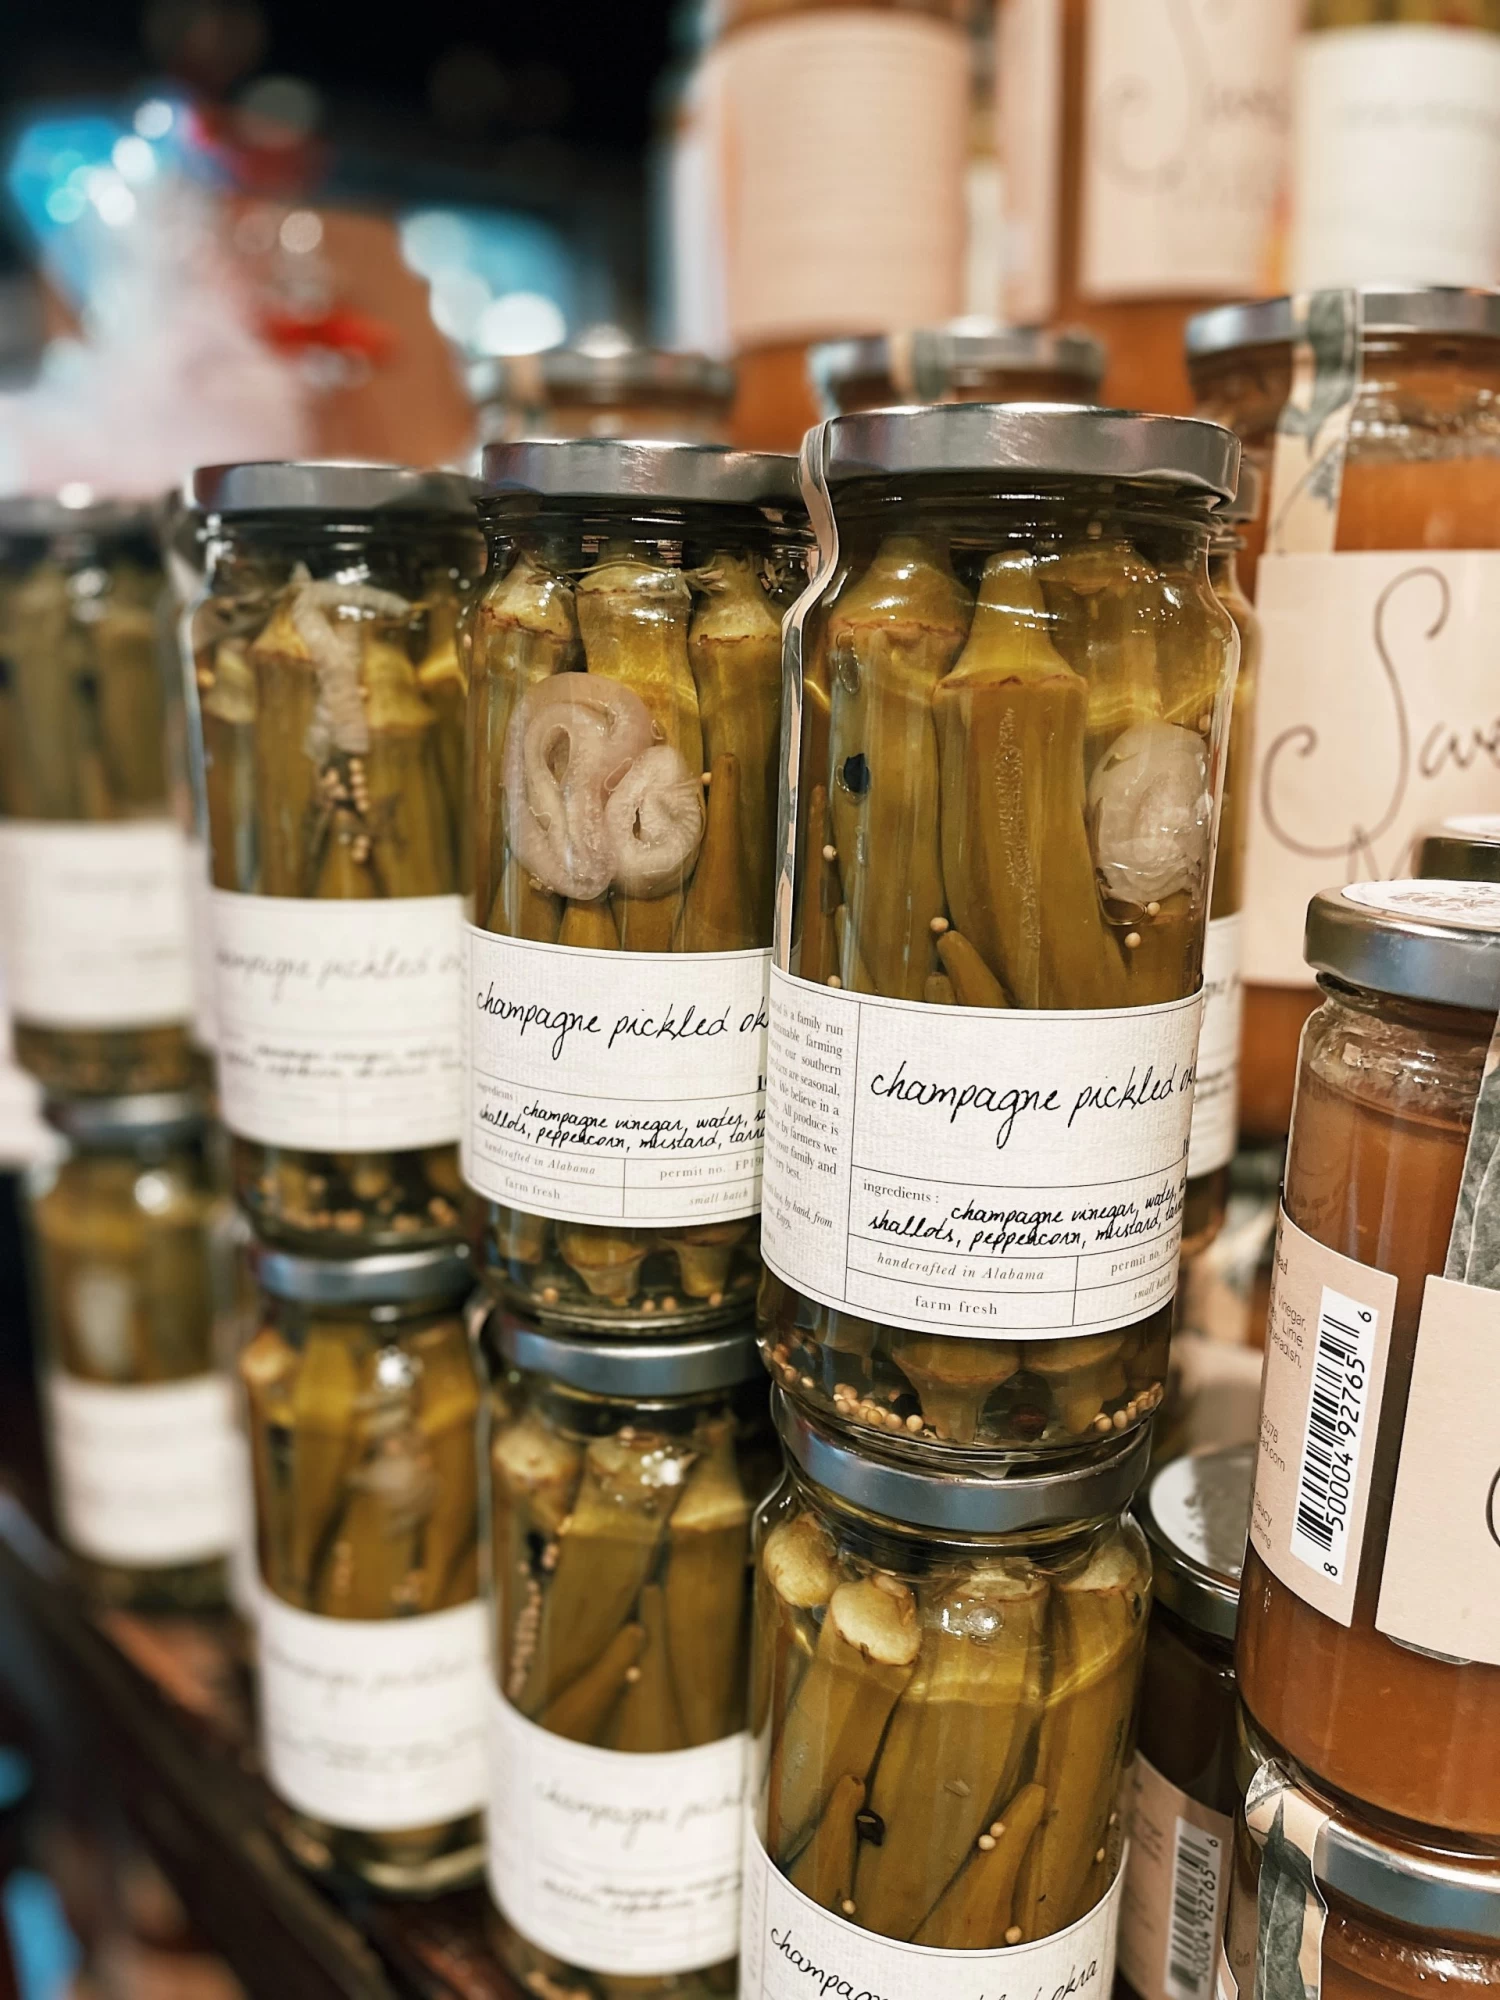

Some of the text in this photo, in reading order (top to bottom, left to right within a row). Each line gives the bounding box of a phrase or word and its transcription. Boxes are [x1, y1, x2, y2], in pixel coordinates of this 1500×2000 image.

[477, 981, 602, 1061] champagne
[608, 1003, 731, 1049] pickled
[739, 996, 769, 1034] ok
[797, 1009, 822, 1034] family
[825, 1022, 844, 1037] run
[806, 1033, 843, 1059] farming
[801, 1055, 842, 1077] southern
[800, 1075, 841, 1098] seasonal,
[790, 1085, 817, 1109] believe
[819, 1098, 830, 1113] in
[832, 1105, 840, 1117] a
[870, 1060, 1061, 1150] champagne
[1068, 1063, 1178, 1129] pickled
[479, 1103, 531, 1140] shallots,
[535, 1125, 631, 1153] peppercorn,
[638, 1129, 722, 1151] mustard,
[523, 1099, 608, 1138] champagne
[614, 1113, 689, 1146] vinegar,
[696, 1106, 748, 1131] water,
[793, 1111, 828, 1133] produce
[830, 1121, 839, 1136] is
[790, 1126, 821, 1150] farmers
[823, 1142, 838, 1156] we
[484, 1139, 597, 1175] handcrafted in Alabama
[790, 1145, 815, 1170] family
[817, 1162, 837, 1175] and
[504, 1176, 561, 1200] farm fresh
[659, 1166, 703, 1182] permit
[708, 1166, 726, 1176] no.
[688, 1192, 719, 1206] small
[863, 1178, 932, 1203] ingredients
[811, 1209, 833, 1229] from
[951, 1199, 1064, 1241] champagne
[1071, 1202, 1140, 1238] vinegar,
[1145, 1179, 1177, 1209] water,
[868, 1209, 962, 1248] shallots,
[968, 1228, 1087, 1254] peppercorn,
[1095, 1208, 1161, 1241] mustard,
[876, 1252, 1045, 1280] handcrafted in Alabama
[1110, 1251, 1147, 1277] permit
[1133, 1278, 1155, 1301] small
[915, 1295, 998, 1315] farm fresh
[1323, 1310, 1373, 1577] 8 50004 92765 6
[770, 1928, 1098, 2000] champa okra
